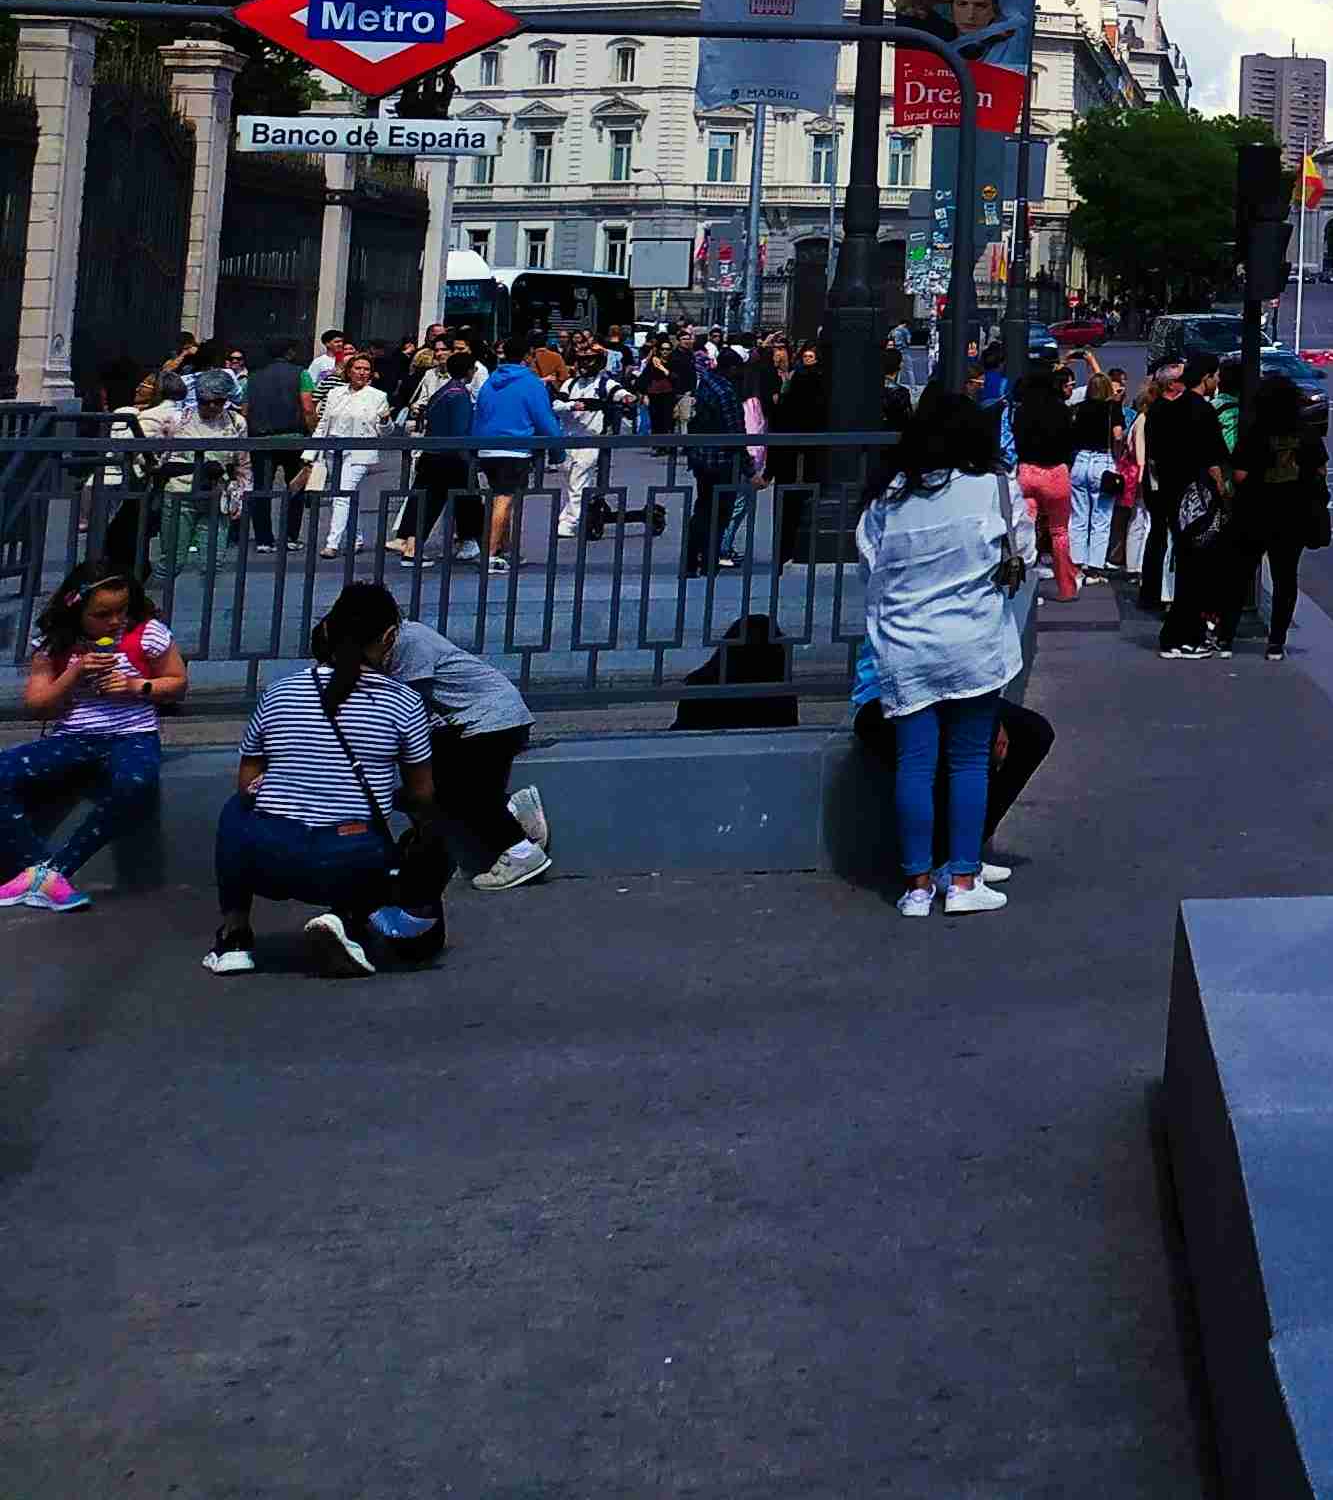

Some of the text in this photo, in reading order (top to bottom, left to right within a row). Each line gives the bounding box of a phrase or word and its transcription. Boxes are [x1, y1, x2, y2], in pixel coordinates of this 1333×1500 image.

[320, 0, 436, 35] Metro
[747, 88, 800, 101] MADRID
[932, 108, 961, 120] Galv
[251, 122, 487, 153] Banco de España
